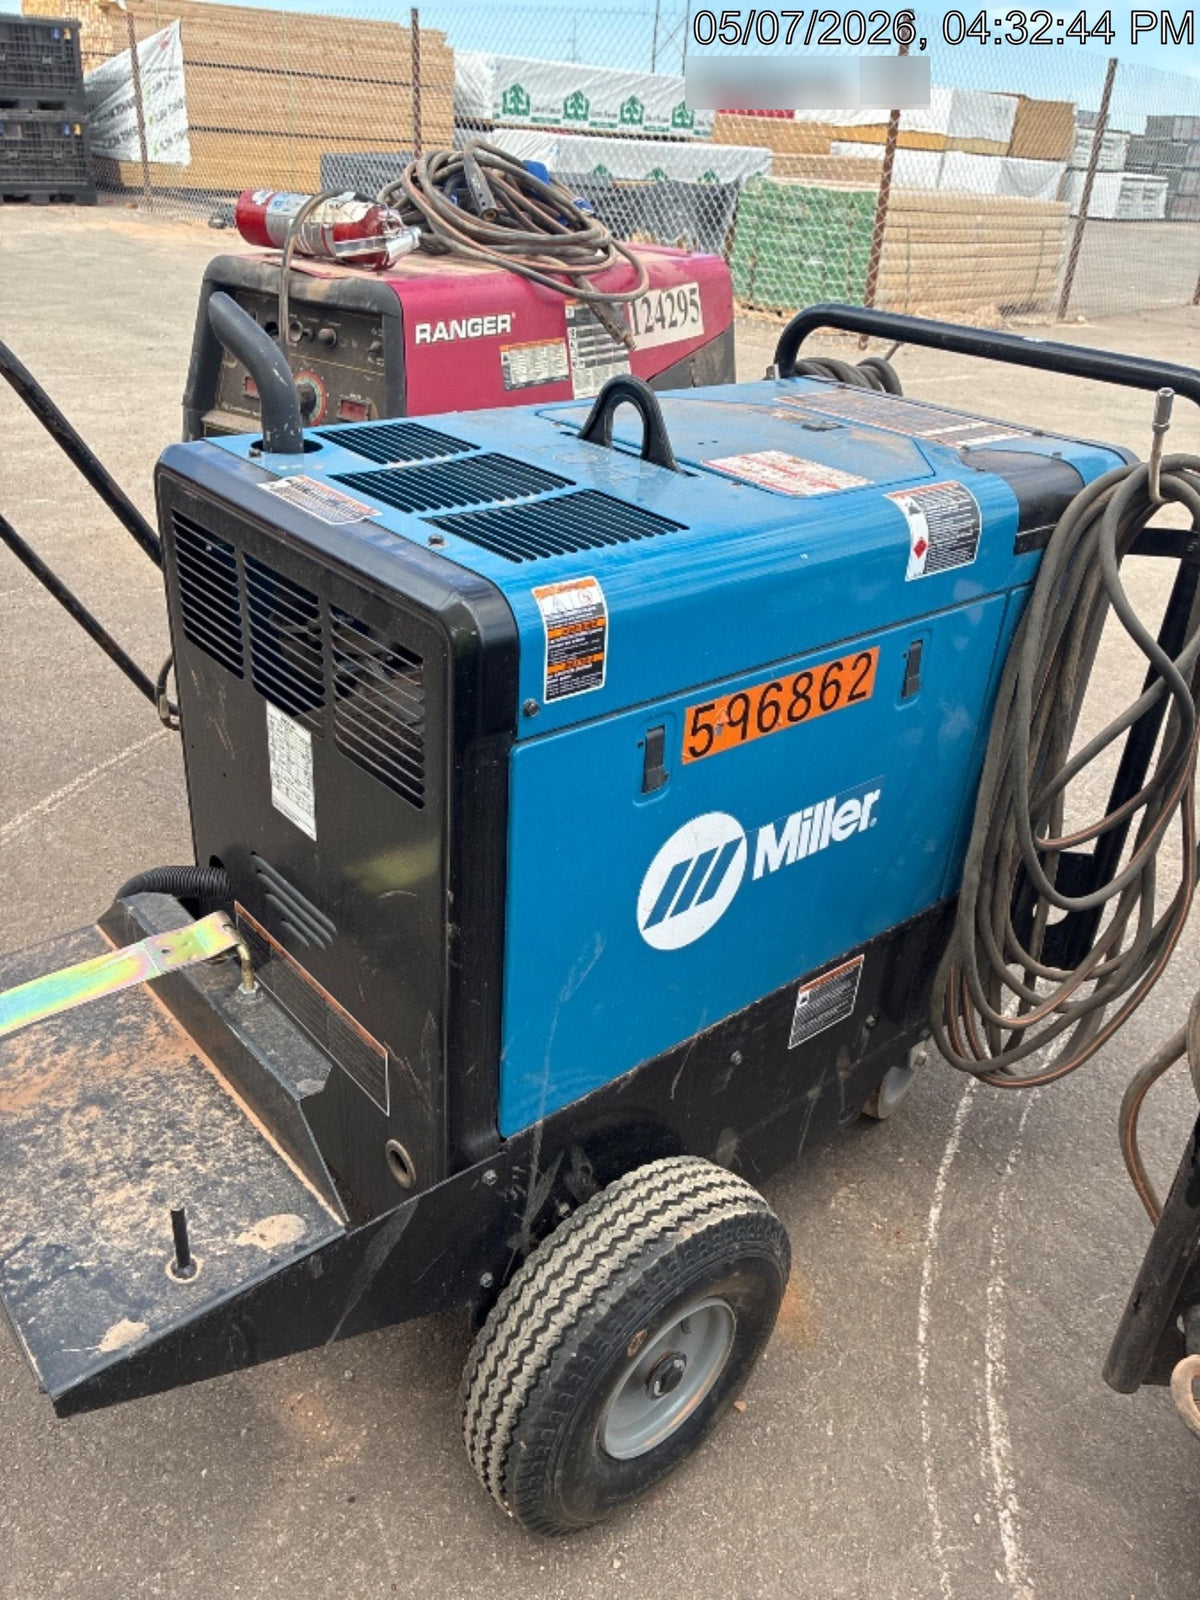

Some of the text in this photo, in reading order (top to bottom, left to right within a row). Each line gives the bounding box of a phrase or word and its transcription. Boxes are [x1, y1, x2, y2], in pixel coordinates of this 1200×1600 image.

[415, 313, 511, 345] RANGER
[631, 287, 700, 336] 124295
[688, 652, 872, 758] 596862
[752, 789, 881, 881] Miller
